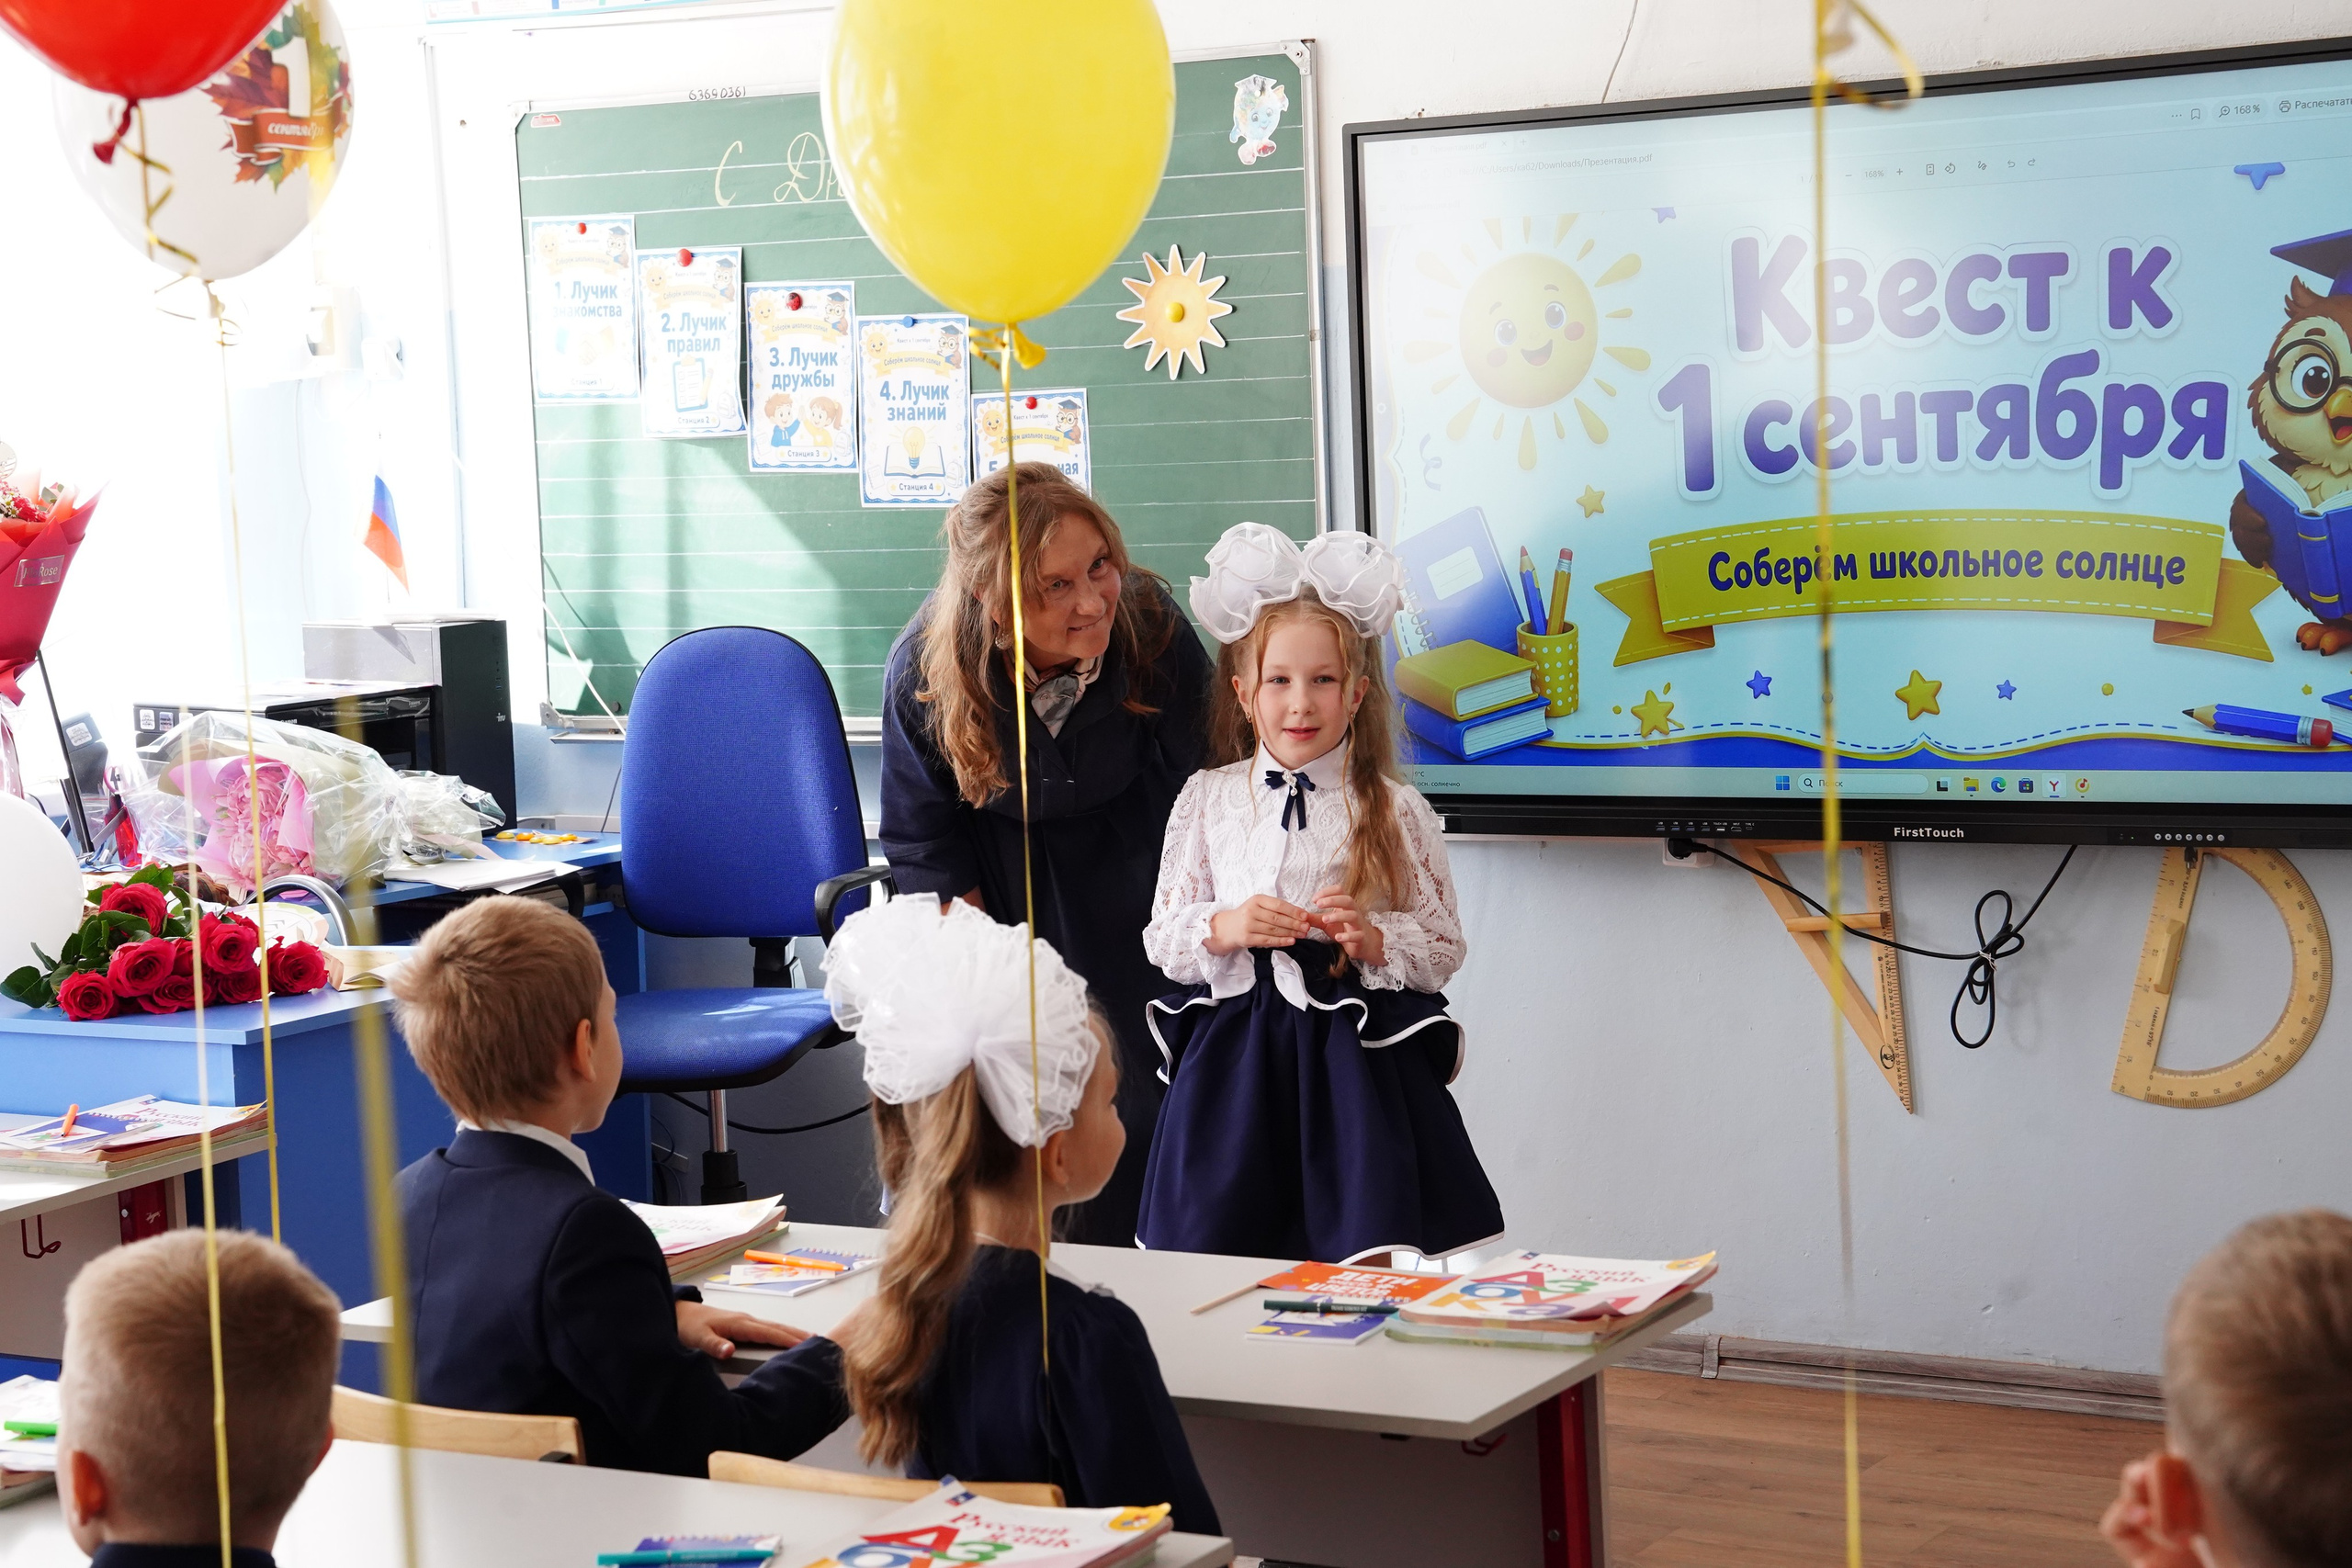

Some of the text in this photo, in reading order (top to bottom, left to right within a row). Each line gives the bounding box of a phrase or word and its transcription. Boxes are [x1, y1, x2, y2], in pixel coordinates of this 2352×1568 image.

[272, 36, 311, 118] 1
[715, 141, 742, 207] С
[571, 281, 618, 304] Лучик
[1731, 234, 2174, 352] Квест к
[552, 306, 622, 318] знакомства
[661, 312, 727, 336] 2. Лучик
[667, 337, 720, 357] правил
[769, 347, 838, 371] 3. Лучик
[772, 369, 834, 392] дружбы
[880, 380, 949, 405] 4. Лучик
[888, 402, 946, 422] знаний
[1657, 348, 2230, 491] 1 сентября
[787, 449, 820, 458] Станция 3
[899, 482, 927, 491] Станция
[1708, 547, 2186, 594] Соберём школьное солнце
[1894, 827, 1964, 838] FirstTouch
[2308, 995, 2315, 1003] 90
[2289, 1037, 2297, 1045] 70
[2274, 1055, 2282, 1063] 60
[2256, 1069, 2264, 1077] 50
[1329, 1270, 1419, 1286] ДЕТИ
[1531, 1262, 1636, 1277] Русский
[948, 1512, 1070, 1538] Русский
